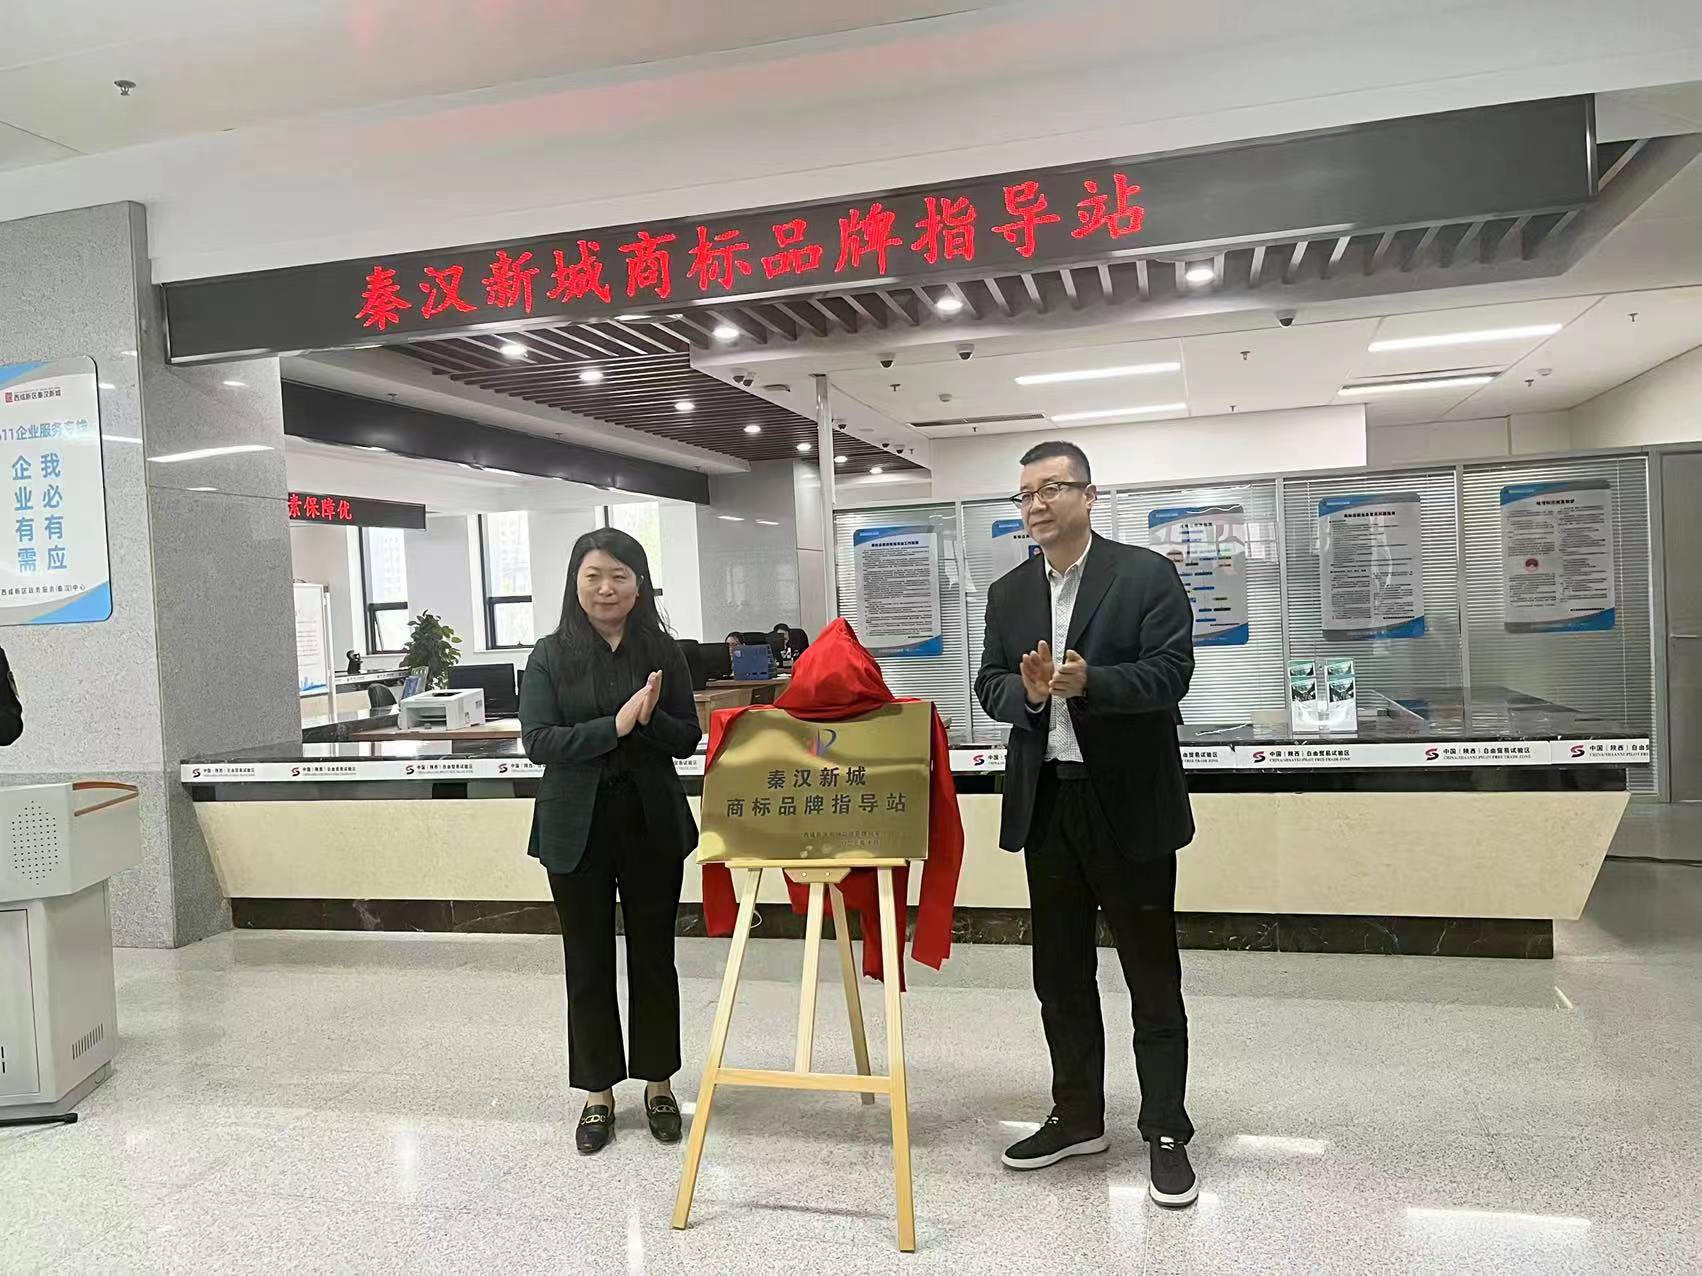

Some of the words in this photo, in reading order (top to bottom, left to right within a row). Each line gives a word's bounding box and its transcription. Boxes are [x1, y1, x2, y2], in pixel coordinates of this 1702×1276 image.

[354, 173, 1145, 331] 秦汉新城商标品牌指导站
[12, 455, 38, 573] 企业有需
[40, 452, 68, 570] 我必有应
[288, 494, 352, 520] 素保障优
[726, 792, 907, 818] 商标品牌指导站
[767, 766, 867, 790] 秦汉新城
